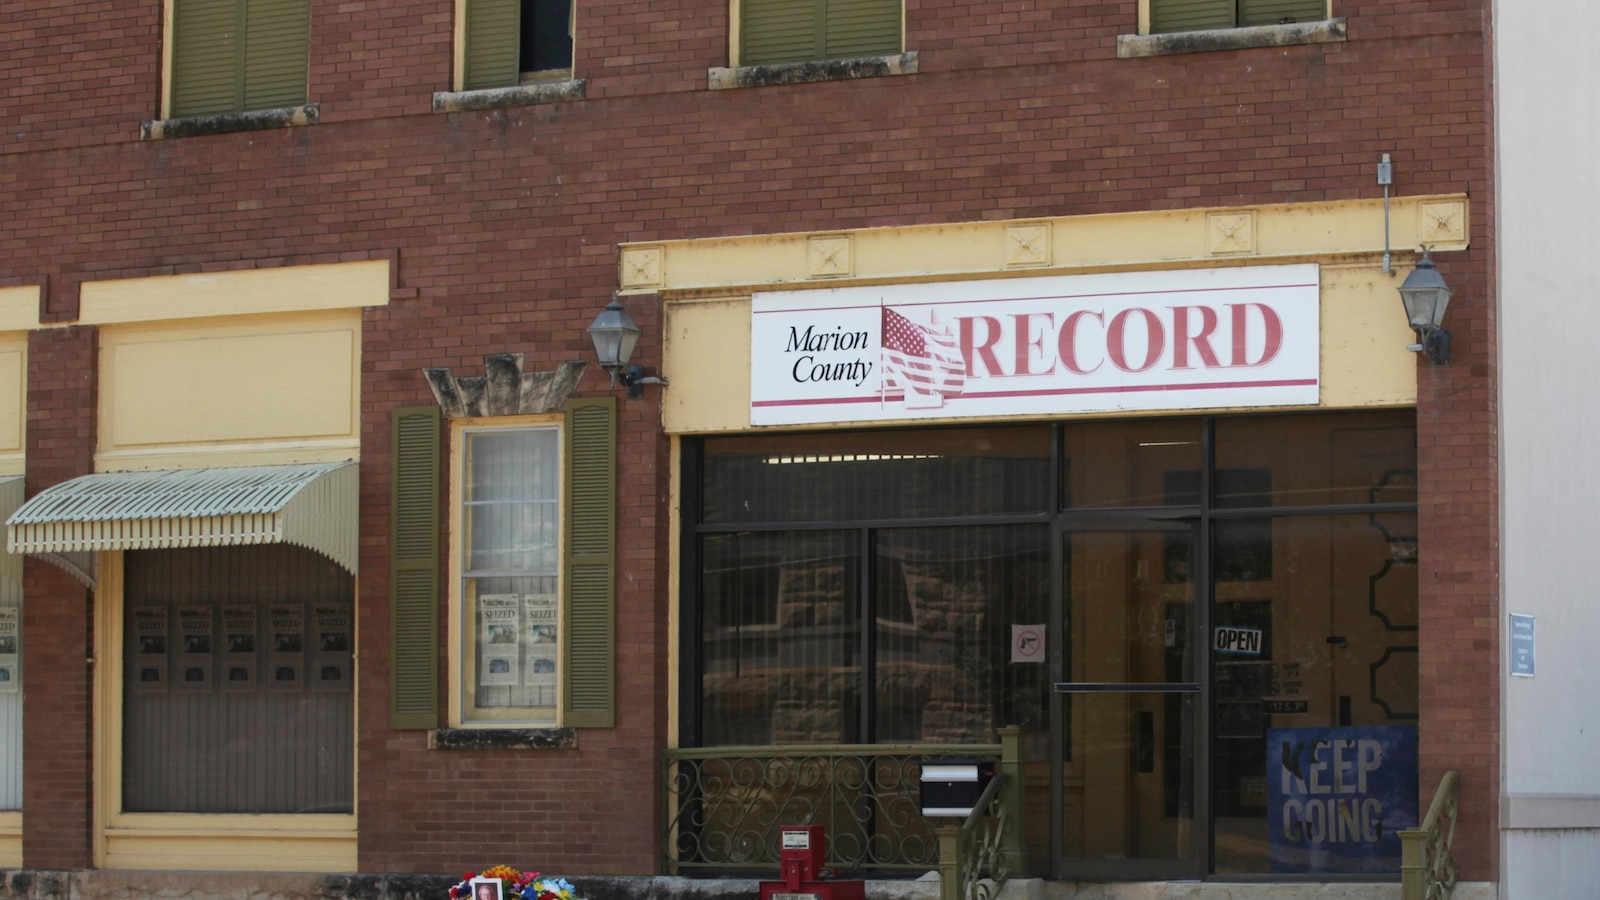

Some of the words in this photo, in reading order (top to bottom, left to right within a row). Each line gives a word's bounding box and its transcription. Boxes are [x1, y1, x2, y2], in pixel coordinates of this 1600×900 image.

[785, 325, 868, 352] Marion
[954, 302, 1284, 379] RECORD
[792, 356, 873, 387] County
[485, 609, 515, 619] SEIZED
[1216, 629, 1259, 652] OPEN
[1281, 739, 1383, 795] KEEP
[1283, 798, 1383, 843] GOING
